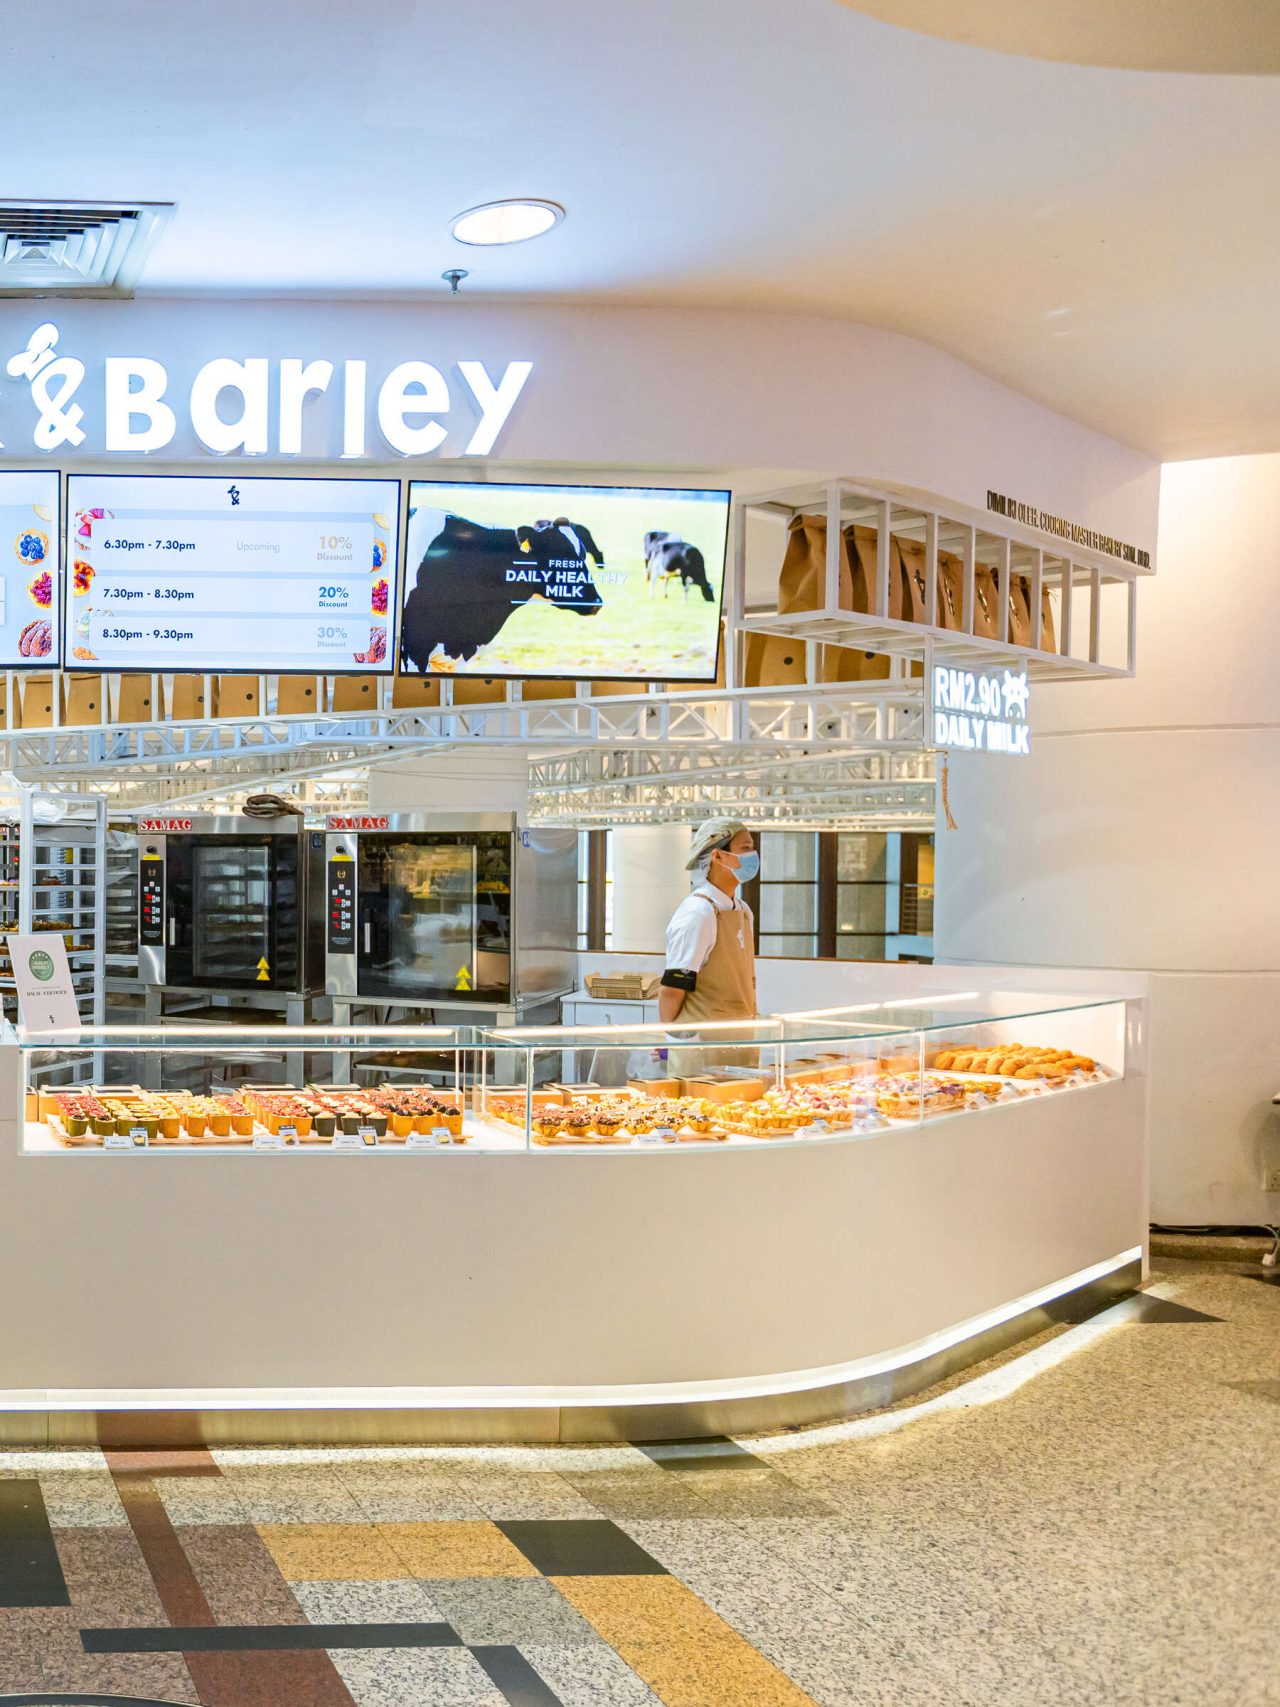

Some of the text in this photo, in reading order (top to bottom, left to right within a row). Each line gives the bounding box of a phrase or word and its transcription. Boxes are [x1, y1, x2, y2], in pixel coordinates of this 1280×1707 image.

[7, 323, 85, 451] &
[106, 358, 532, 457] Barley
[320, 536, 353, 550] 10%
[1071, 523, 1098, 550] MASTER
[104, 540, 145, 551] 6.30pm
[155, 541, 196, 552] 7.30pm
[236, 542, 281, 554] Upcoming
[317, 553, 353, 561] Discount
[548, 560, 583, 568] FRESH
[505, 570, 553, 583] DAILY
[103, 589, 144, 600] 7.30pm
[154, 589, 194, 601] 8.30pm
[318, 587, 349, 598] 20%
[545, 585, 584, 598] MILK
[102, 629, 143, 641] 8.30pm
[153, 630, 194, 641] 9.30pm
[317, 627, 348, 639] 30%
[935, 666, 1001, 717] RM2.90
[935, 713, 1030, 754] DAILY MILK
[140, 818, 193, 831] SAMAG
[328, 816, 389, 829] SAMAG
